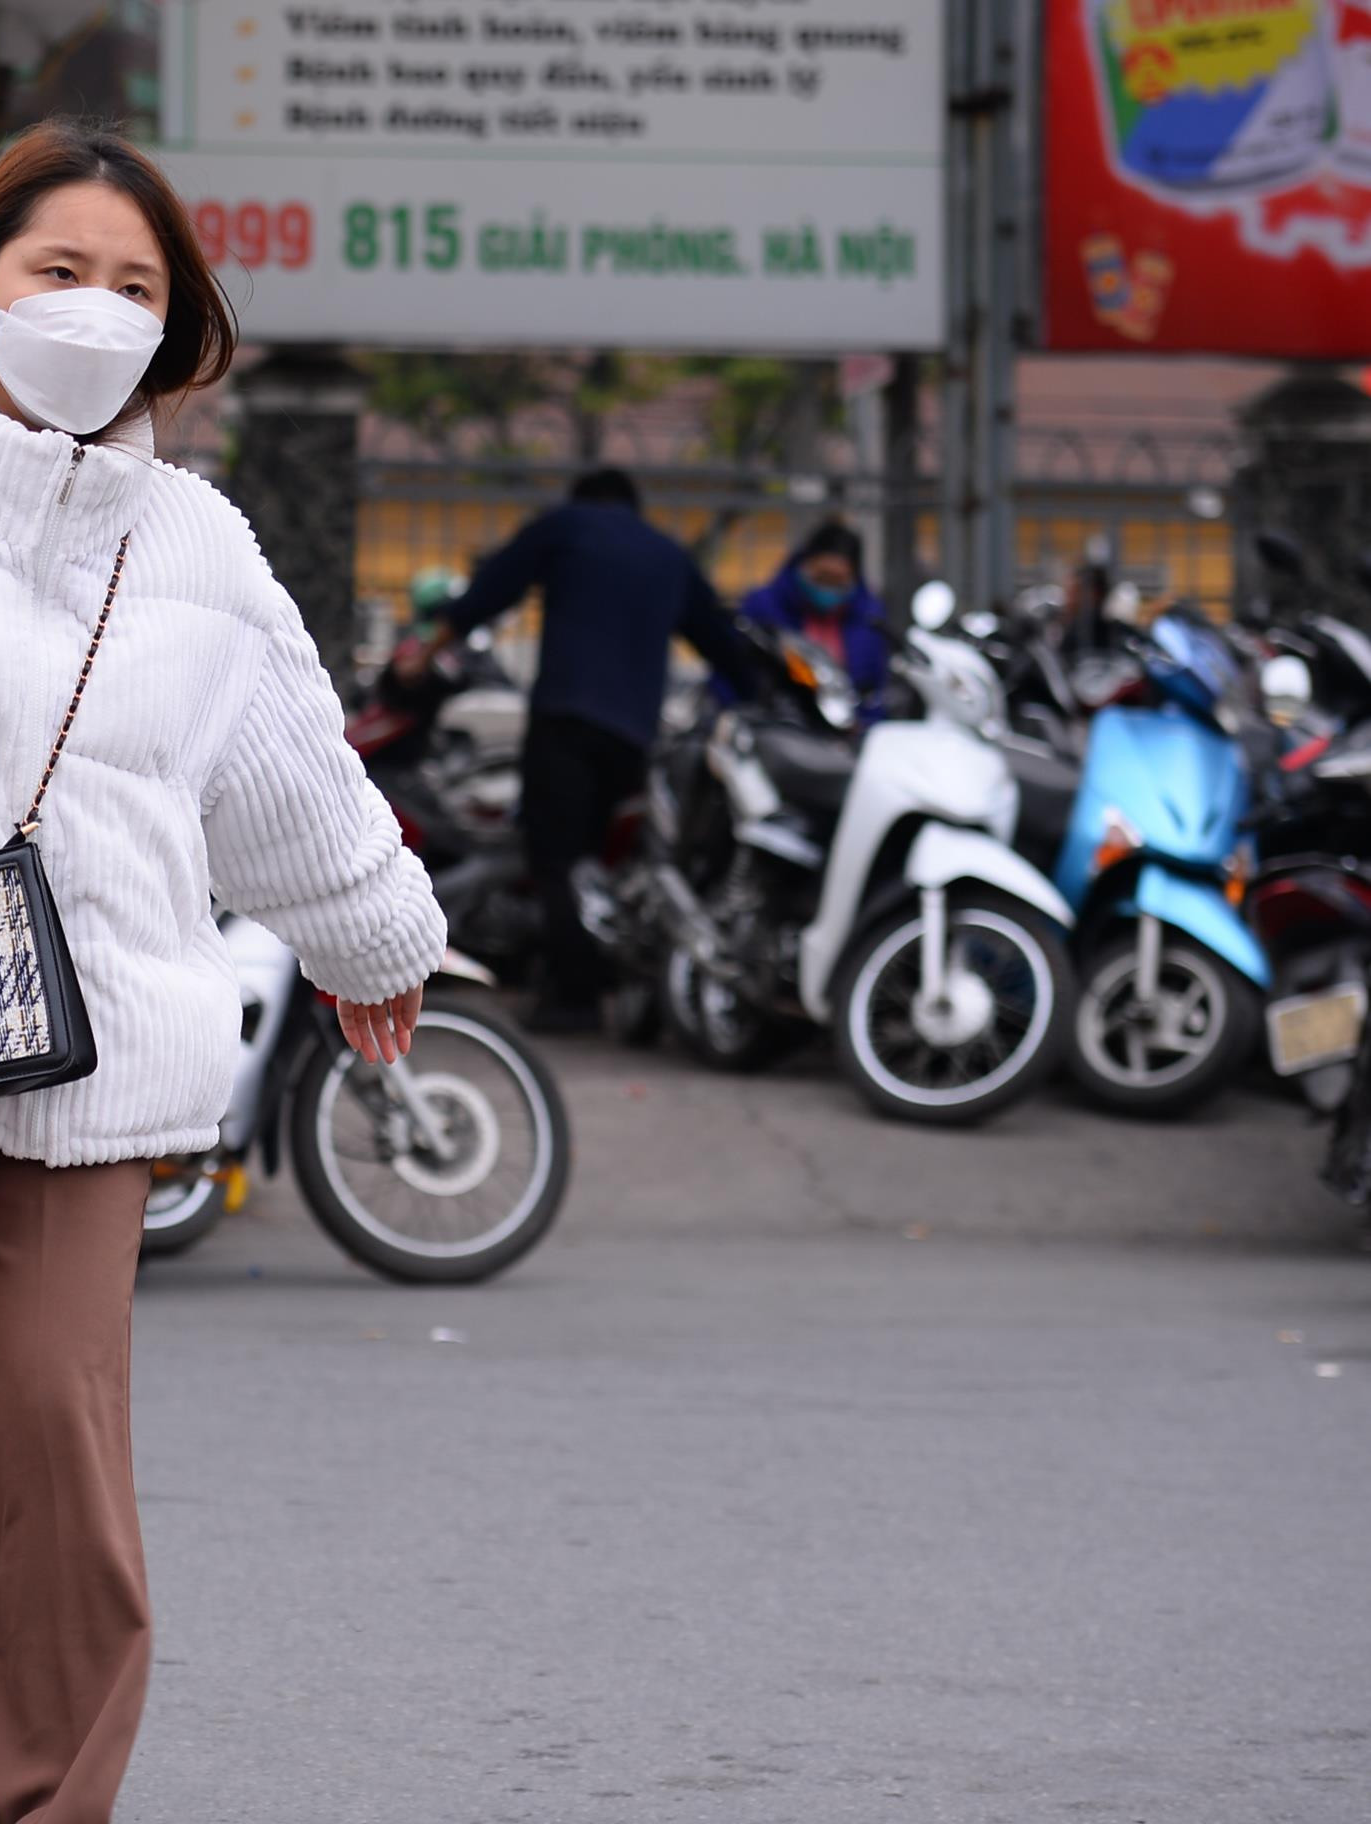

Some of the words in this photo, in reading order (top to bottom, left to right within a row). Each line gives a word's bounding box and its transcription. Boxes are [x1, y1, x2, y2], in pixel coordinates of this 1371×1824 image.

[285, 56, 372, 94] Bệnh
[462, 64, 527, 97] quy
[285, 102, 370, 140] Bệnh
[343, 202, 461, 271] 815
[762, 216, 824, 278] HÀ
[836, 218, 916, 290] NỘI
